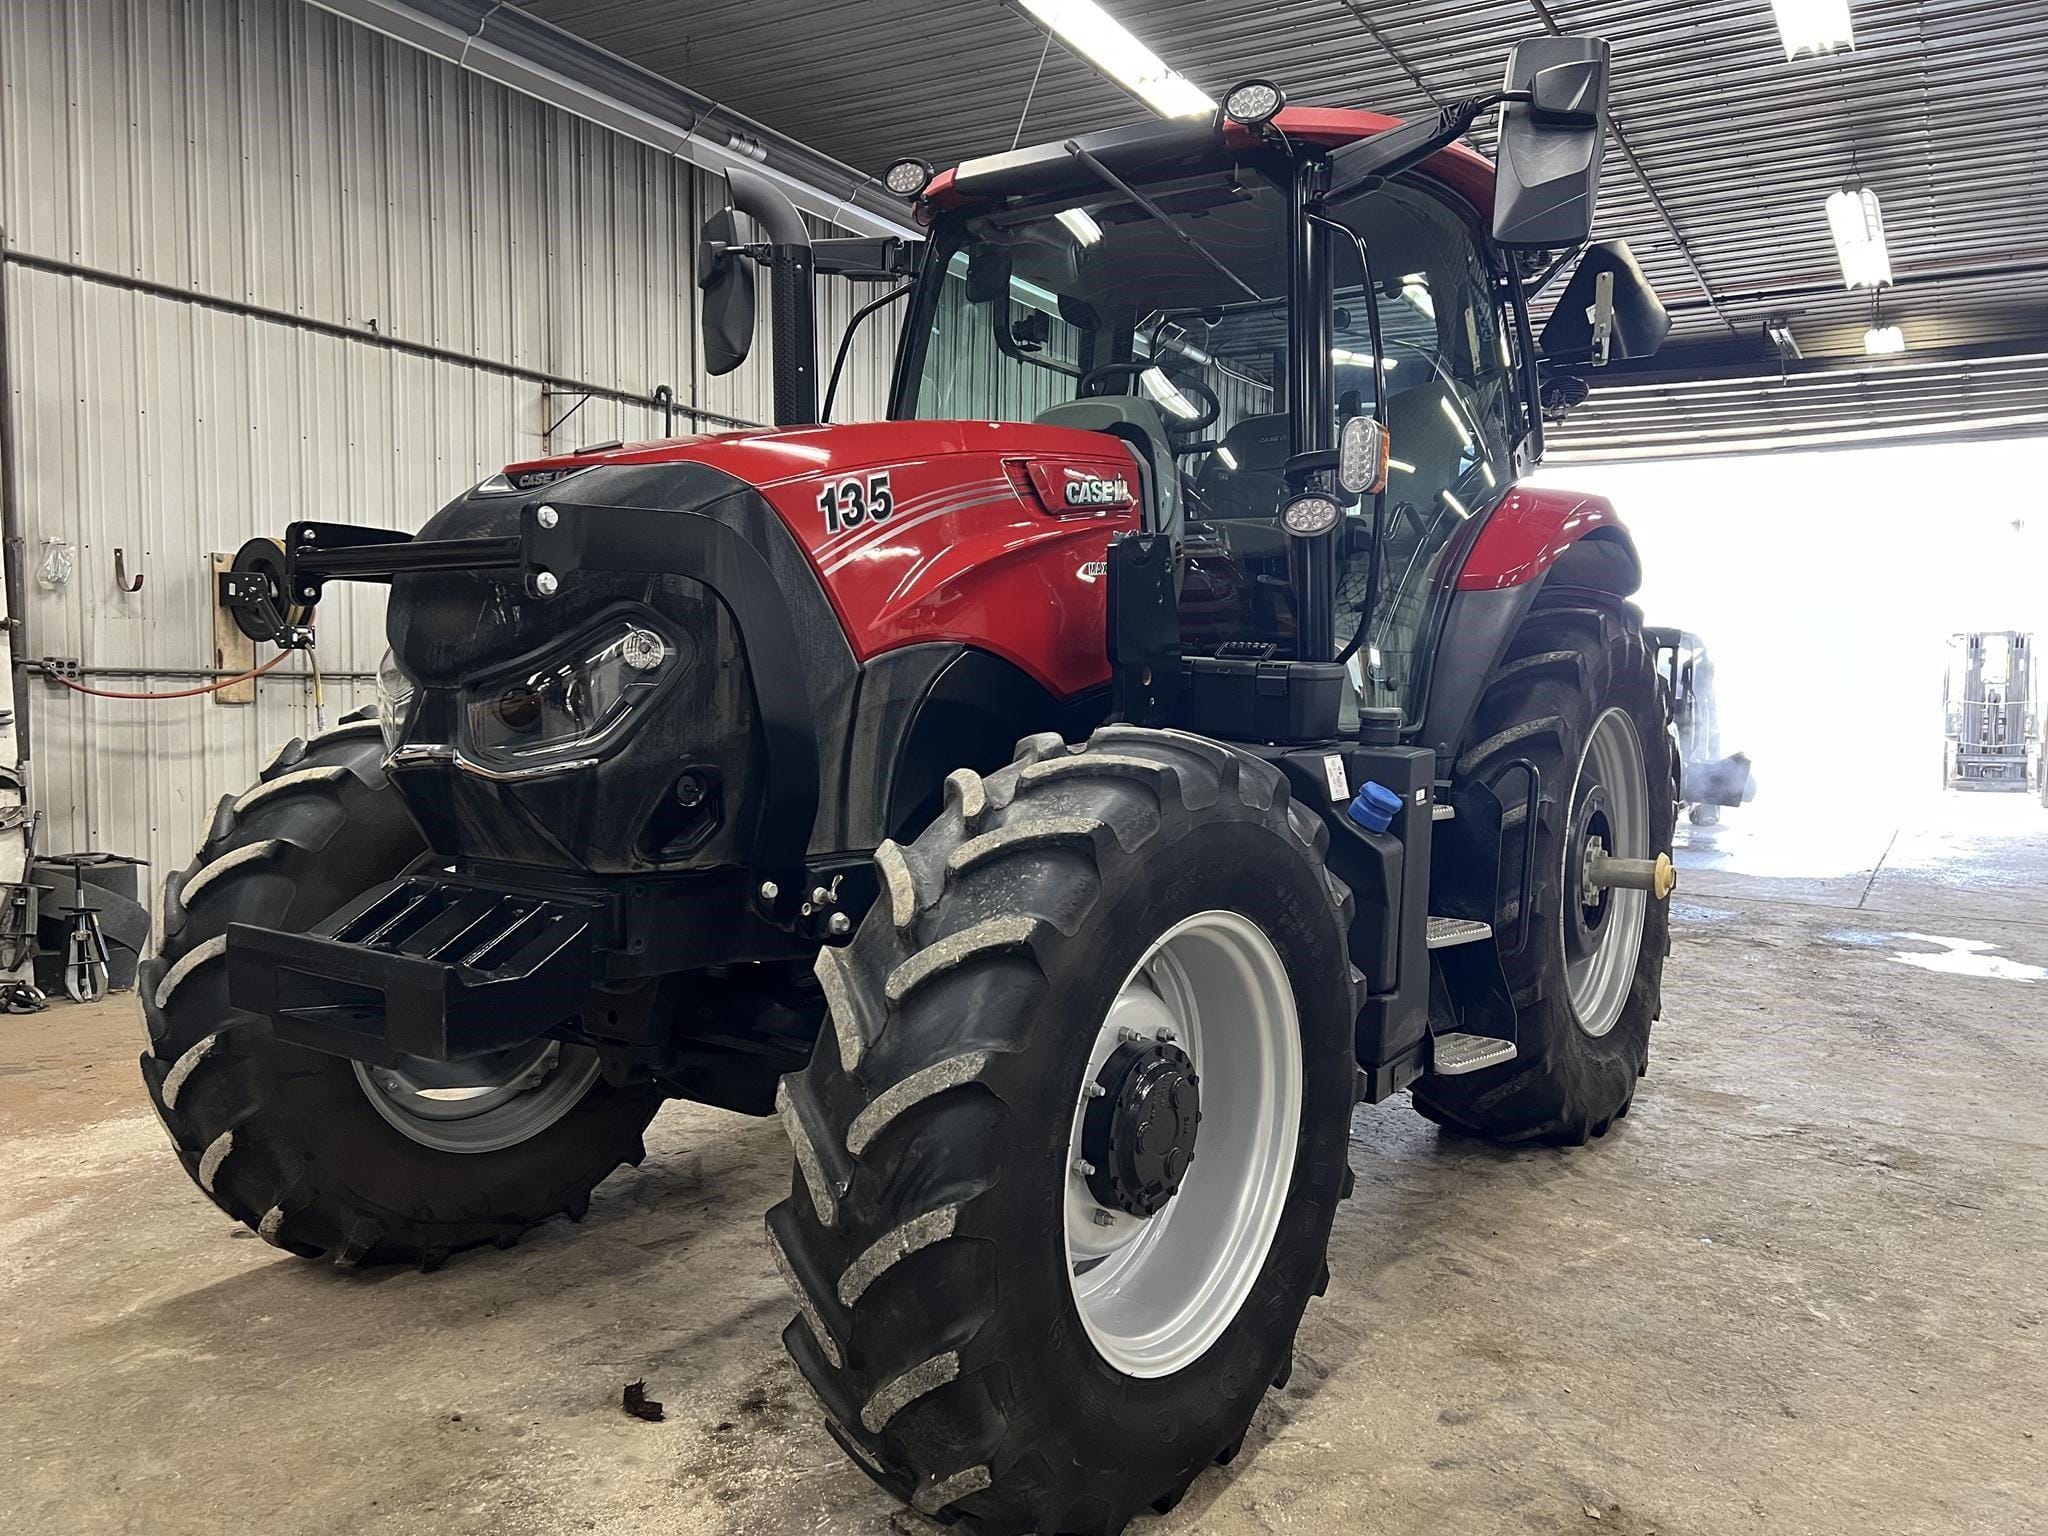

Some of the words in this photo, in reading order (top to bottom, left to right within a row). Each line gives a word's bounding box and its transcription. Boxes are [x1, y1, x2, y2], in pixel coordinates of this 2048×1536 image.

[519, 472, 553, 487] CASE
[1066, 480, 1114, 504] CASE
[816, 470, 894, 535] 135
[1088, 561, 1108, 576] MAX
